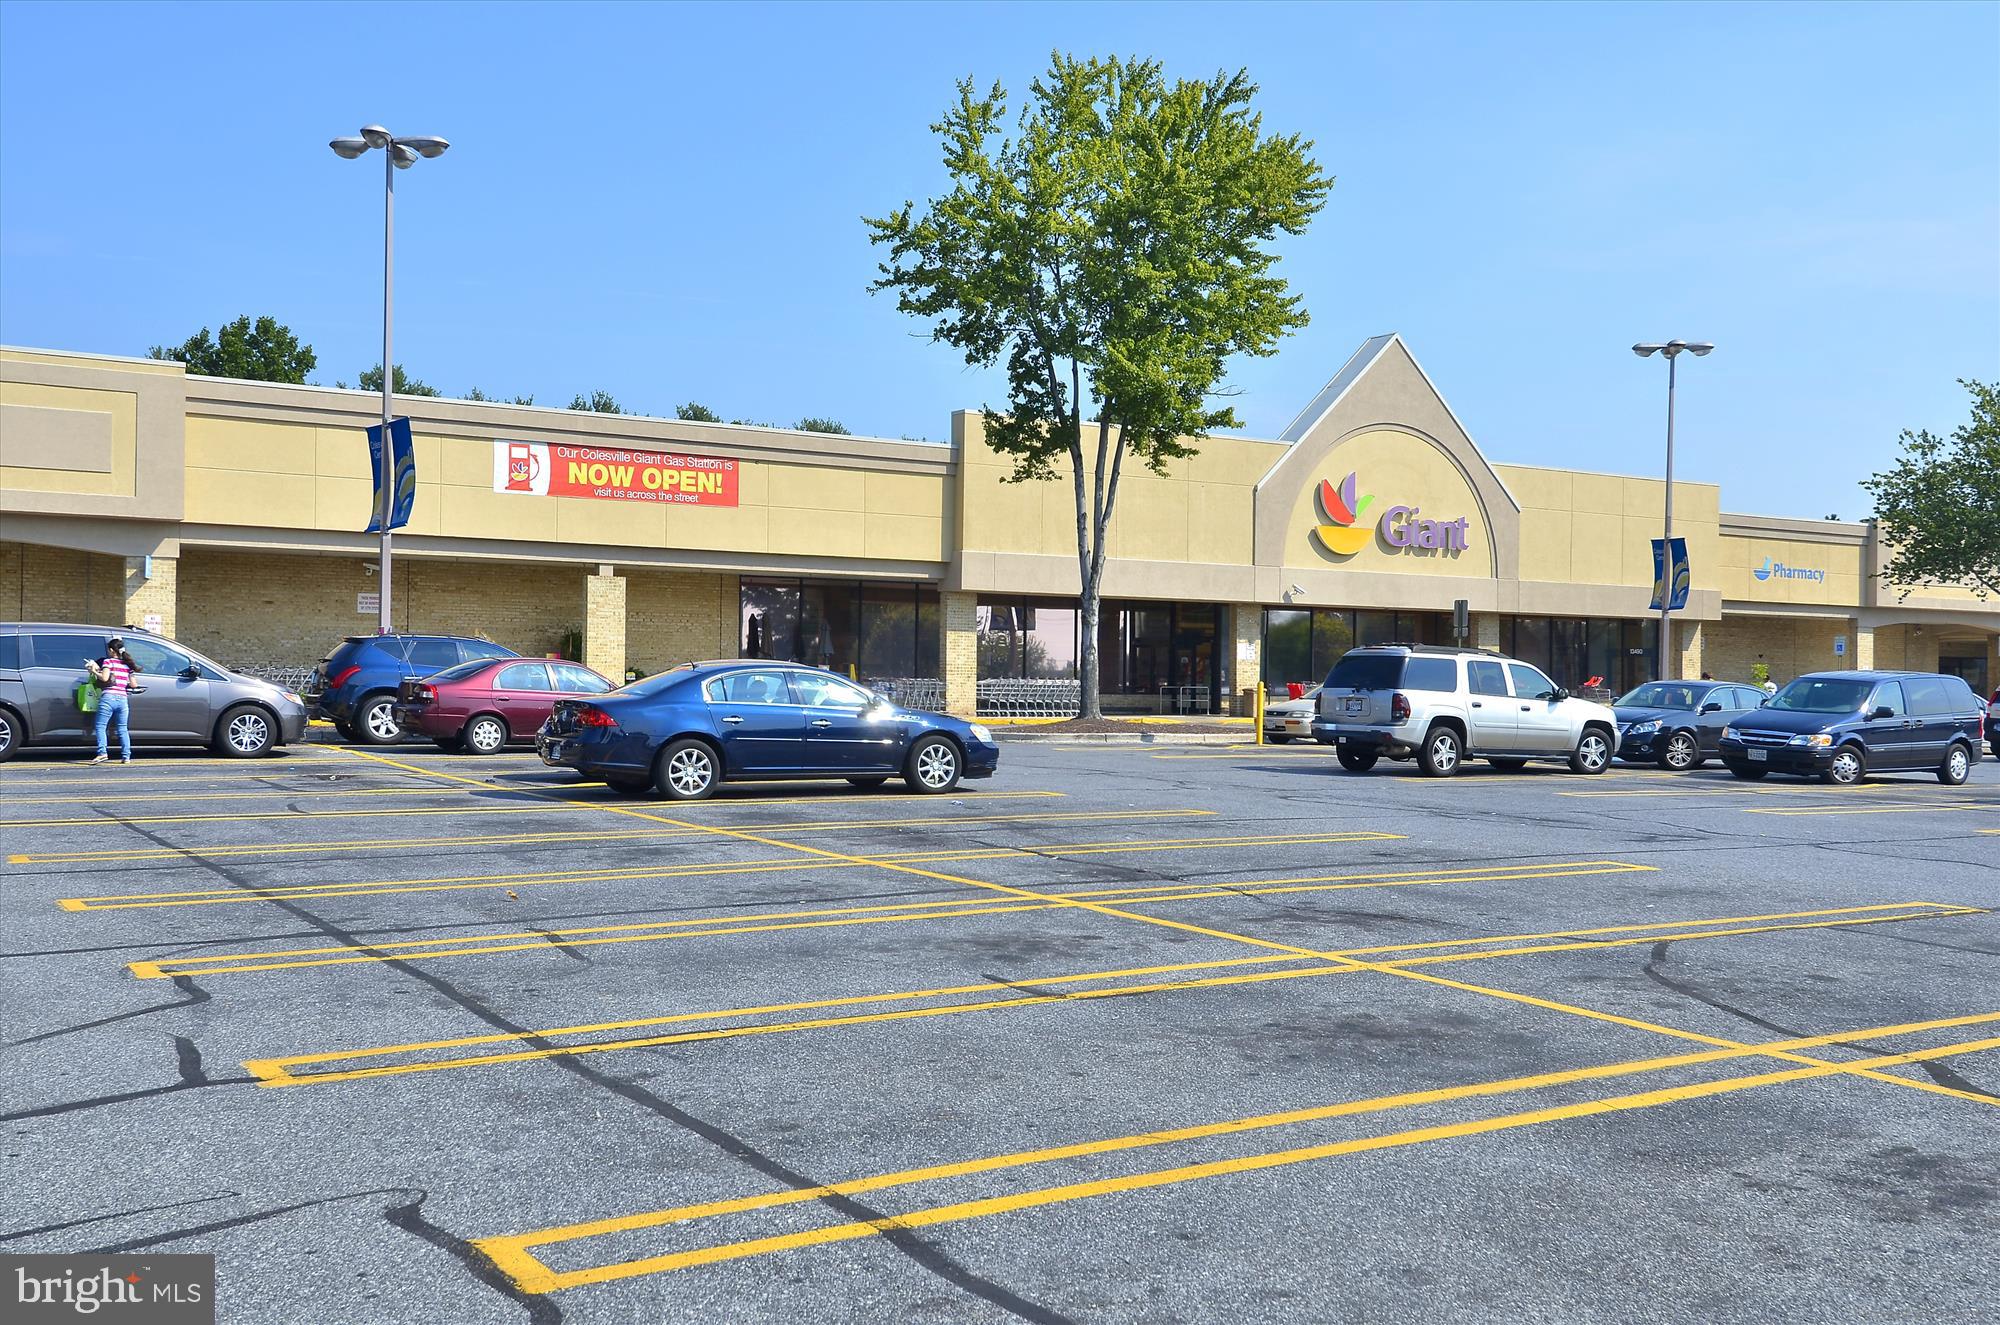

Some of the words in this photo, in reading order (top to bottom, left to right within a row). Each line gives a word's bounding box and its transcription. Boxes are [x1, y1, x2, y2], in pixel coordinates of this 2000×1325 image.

[557, 447, 578, 458] Our
[580, 448, 631, 462] Colesville
[633, 452, 661, 464] Giant
[663, 455, 685, 467] Gas
[687, 456, 722, 469] Station
[724, 460, 733, 470] is
[568, 461, 635, 488] NOW
[642, 467, 723, 494] OPEN!
[593, 488, 612, 497] visit
[626, 491, 656, 500] across
[658, 491, 673, 500] the
[674, 493, 699, 502] street
[1382, 504, 1470, 551] Giant
[1773, 563, 1825, 584] Pharmacy
